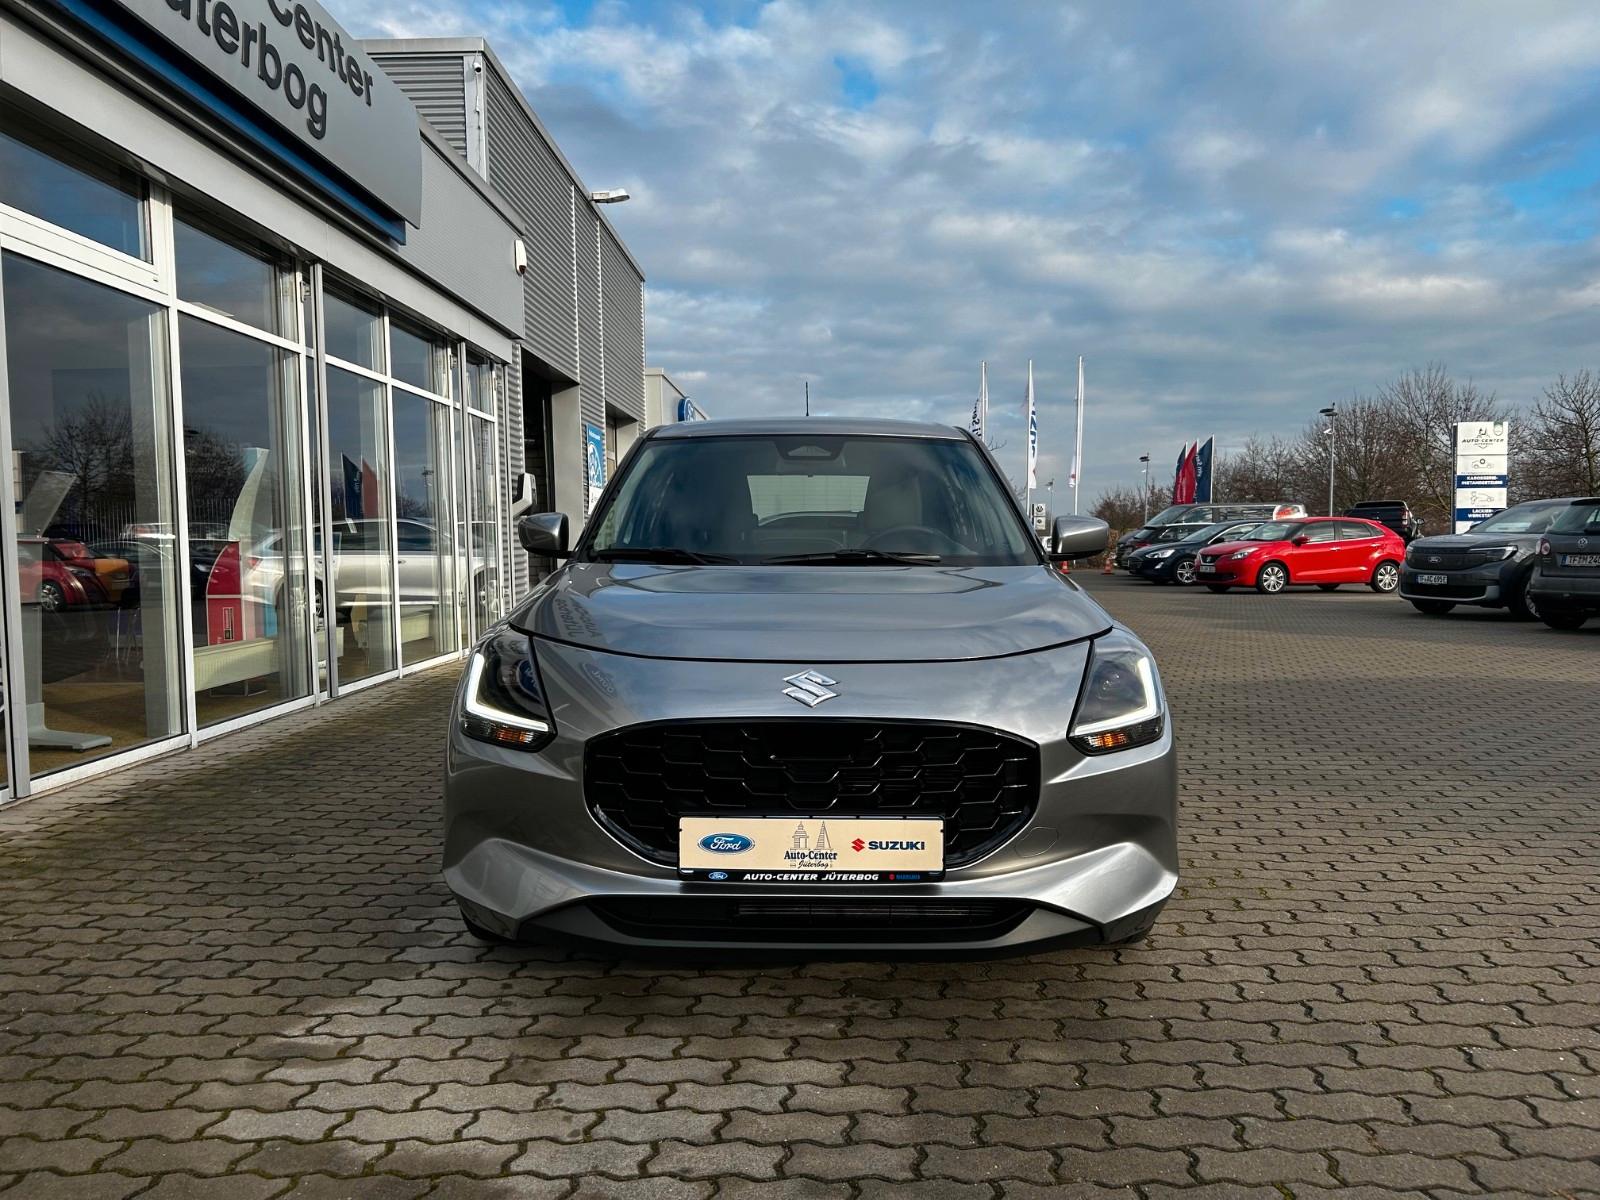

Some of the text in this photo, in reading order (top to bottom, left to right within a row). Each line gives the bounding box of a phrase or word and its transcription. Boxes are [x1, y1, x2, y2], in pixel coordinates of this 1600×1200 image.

[709, 836, 742, 850] Ford
[868, 840, 925, 851] SUZUKI
[784, 850, 838, 860] Auto-Center
[743, 872, 879, 881] AUTO-CENTER JÜTERBOG
